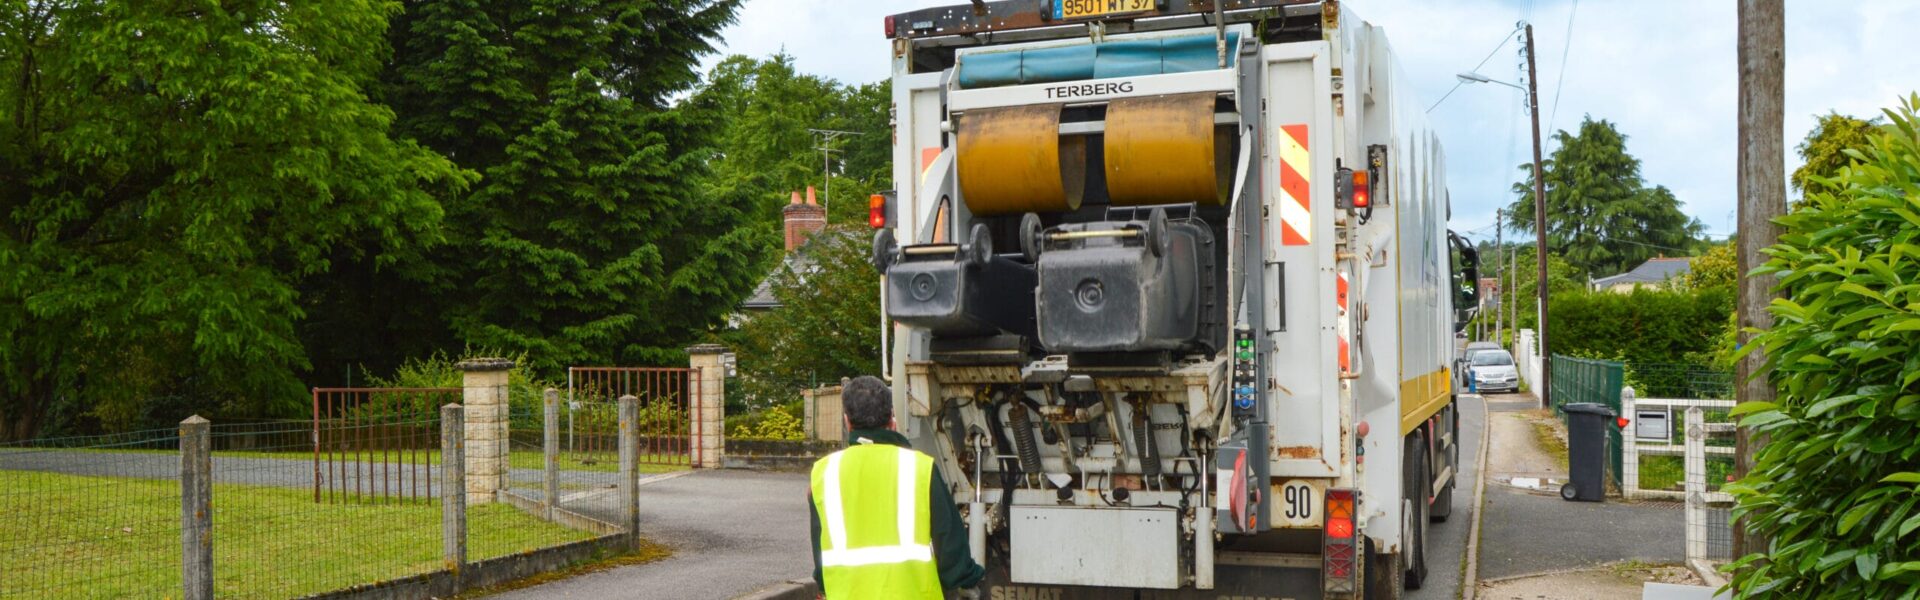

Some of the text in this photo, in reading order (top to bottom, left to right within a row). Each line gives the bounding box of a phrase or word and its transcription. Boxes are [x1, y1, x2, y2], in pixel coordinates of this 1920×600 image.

[1064, 0, 1102, 15] 9501
[1044, 81, 1133, 98] TERBERG
[1285, 485, 1310, 519] 90
[990, 585, 1063, 600] SEMAT
